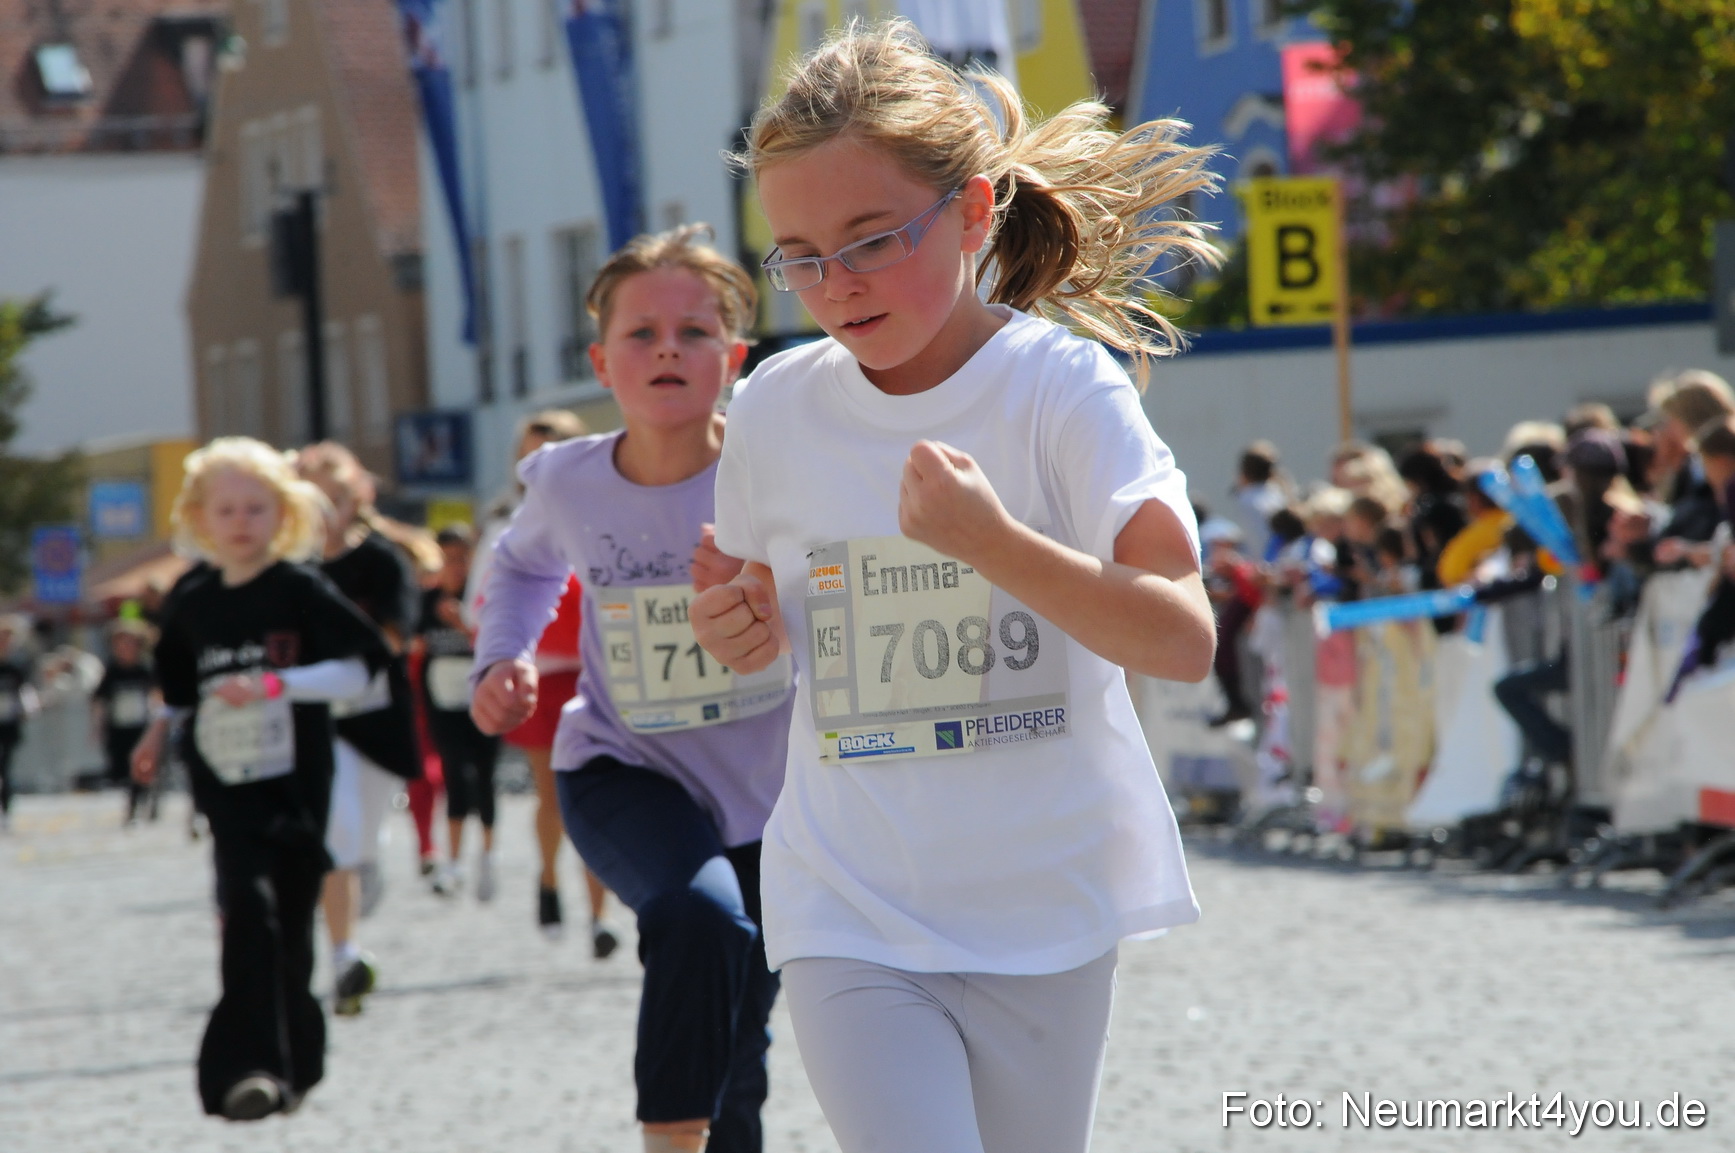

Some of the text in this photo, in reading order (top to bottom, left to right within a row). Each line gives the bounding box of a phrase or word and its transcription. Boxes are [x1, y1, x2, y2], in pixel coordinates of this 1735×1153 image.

[1277, 224, 1321, 290] B
[861, 554, 974, 596] Emma-
[816, 625, 842, 659] K5
[869, 611, 1040, 683] 7089
[653, 642, 730, 682] 71
[966, 707, 1066, 736] PFLEIDERER
[967, 726, 1066, 748] AKTIENGESELLSCHAFT
[838, 732, 896, 753] BOCK
